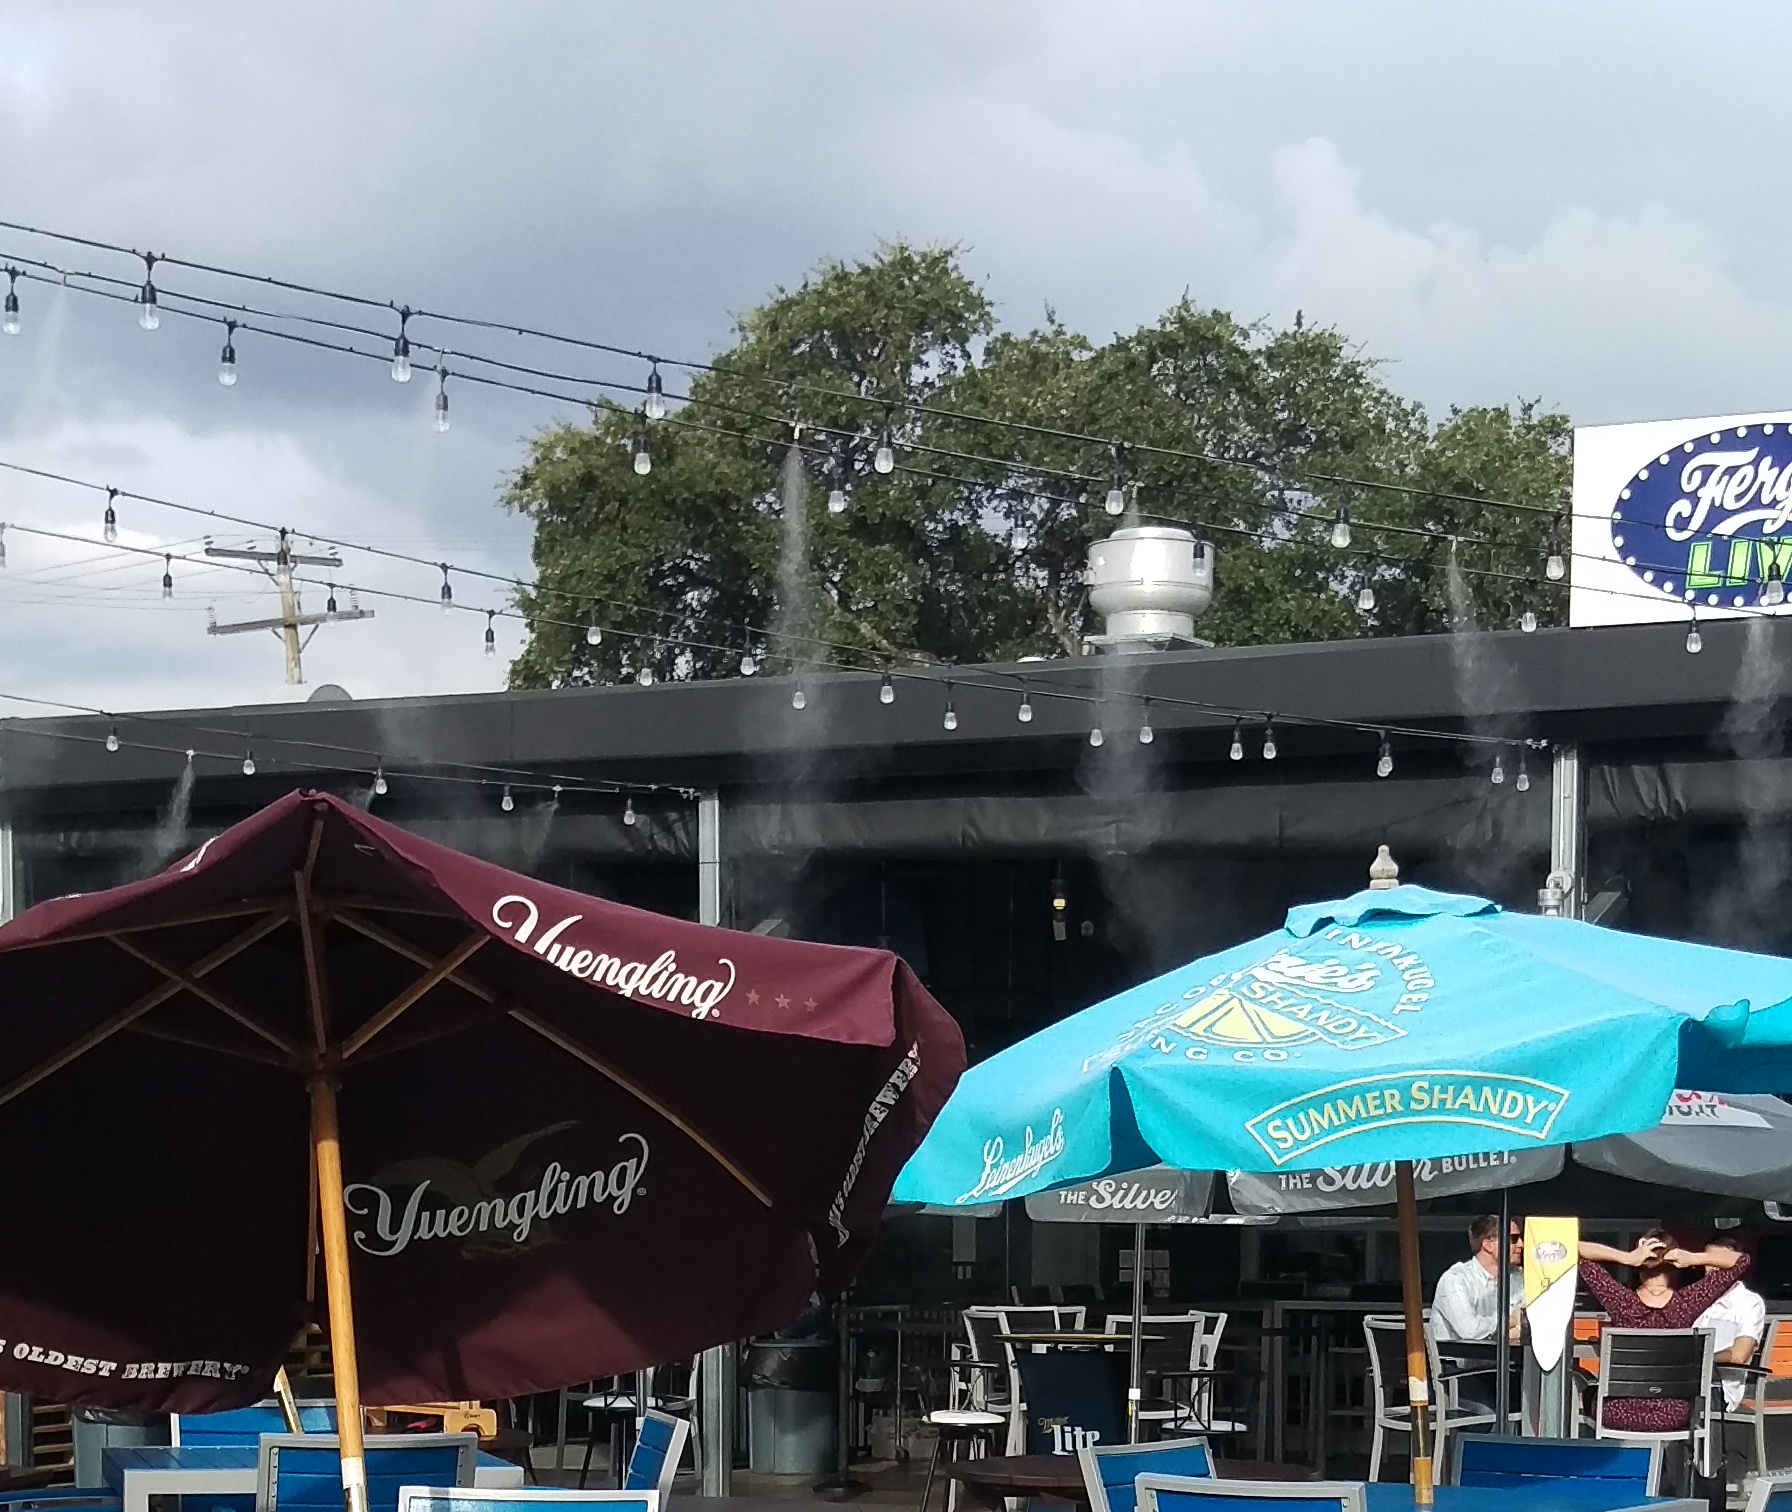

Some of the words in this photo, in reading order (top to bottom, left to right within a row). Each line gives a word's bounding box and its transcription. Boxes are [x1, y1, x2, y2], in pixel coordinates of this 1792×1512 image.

[492, 895, 736, 1020] Yuengling
[1266, 1088, 1404, 1150] SUMMER
[1410, 1080, 1551, 1125] SHANDY
[344, 1133, 650, 1257] Yuengling
[1058, 1190, 1087, 1205] THE
[1088, 1179, 1178, 1210] Silve
[1278, 1172, 1313, 1191] THE
[12, 1341, 119, 1378] OLDEST
[120, 1358, 242, 1381] BREWERY
